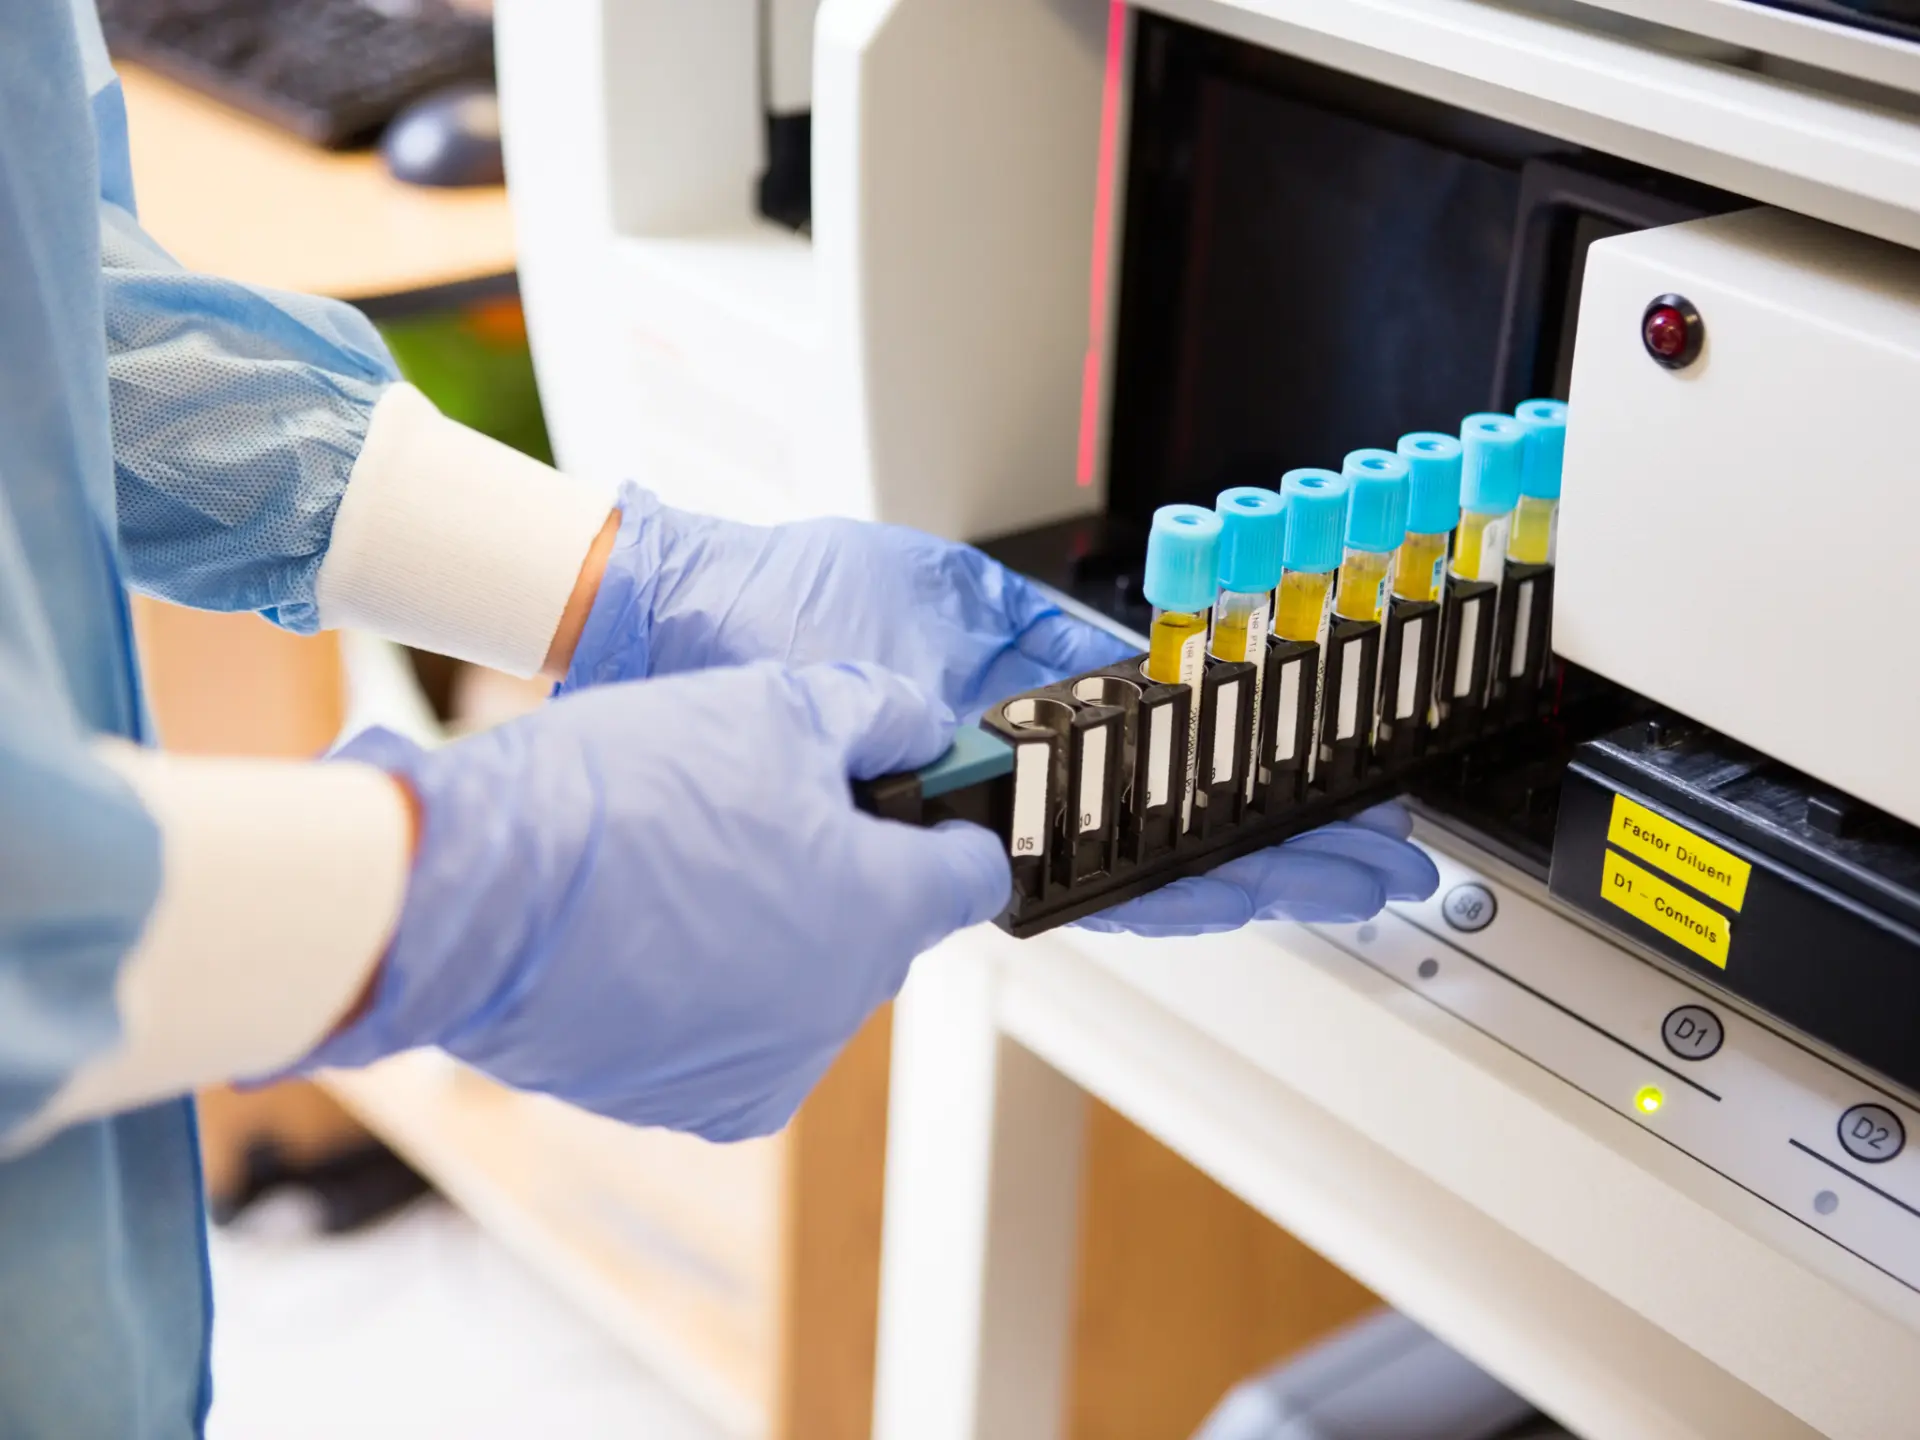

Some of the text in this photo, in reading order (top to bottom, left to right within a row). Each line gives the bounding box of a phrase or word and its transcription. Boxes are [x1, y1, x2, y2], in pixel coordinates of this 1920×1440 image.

[1017, 837, 1034, 851] 05
[1622, 816, 1733, 887] Factor Diluent
[1613, 873, 1633, 893] D1
[1654, 897, 1717, 943] Controls
[1674, 1016, 1708, 1048] D1
[1851, 1115, 1890, 1150] D2
